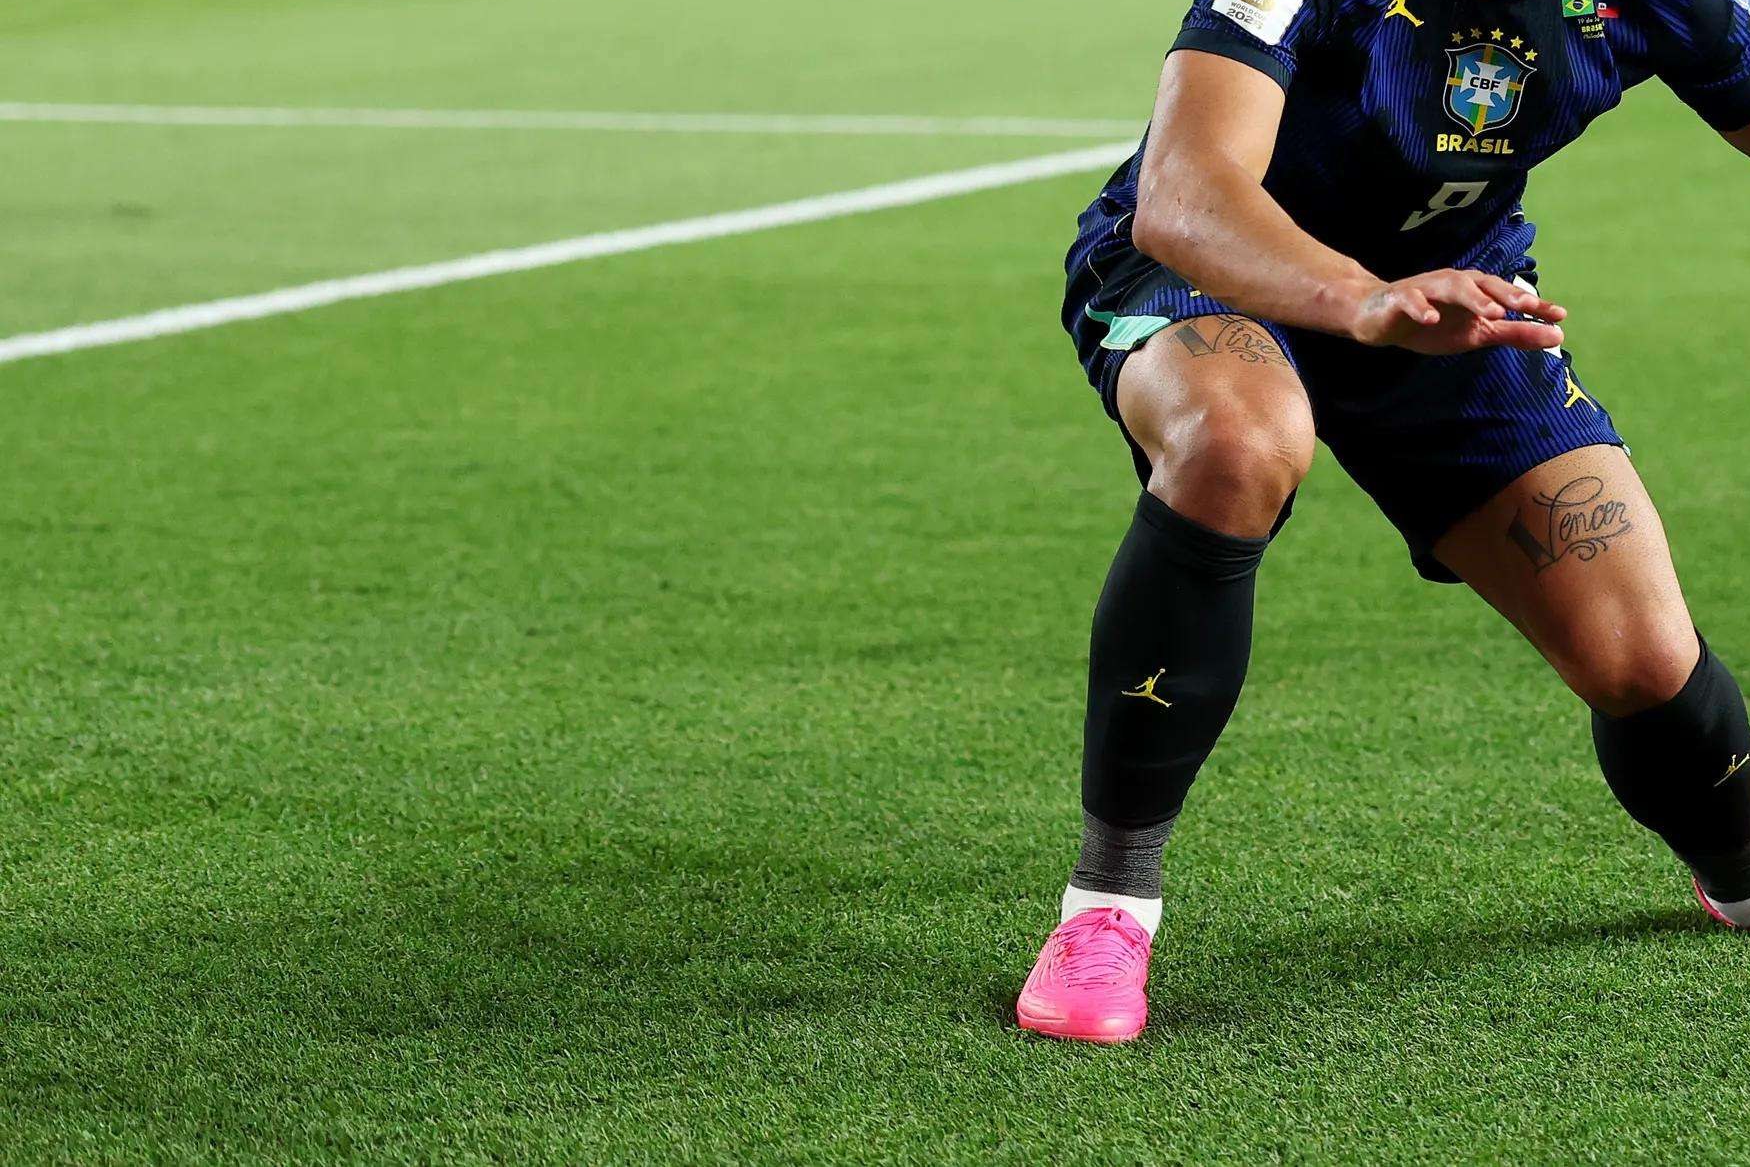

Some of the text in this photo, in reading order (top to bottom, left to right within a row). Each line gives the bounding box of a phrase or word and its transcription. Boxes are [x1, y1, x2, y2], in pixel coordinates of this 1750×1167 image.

[1469, 76, 1501, 91] CBF
[1436, 133, 1514, 155] BRASIL
[1400, 181, 1489, 231] 9
